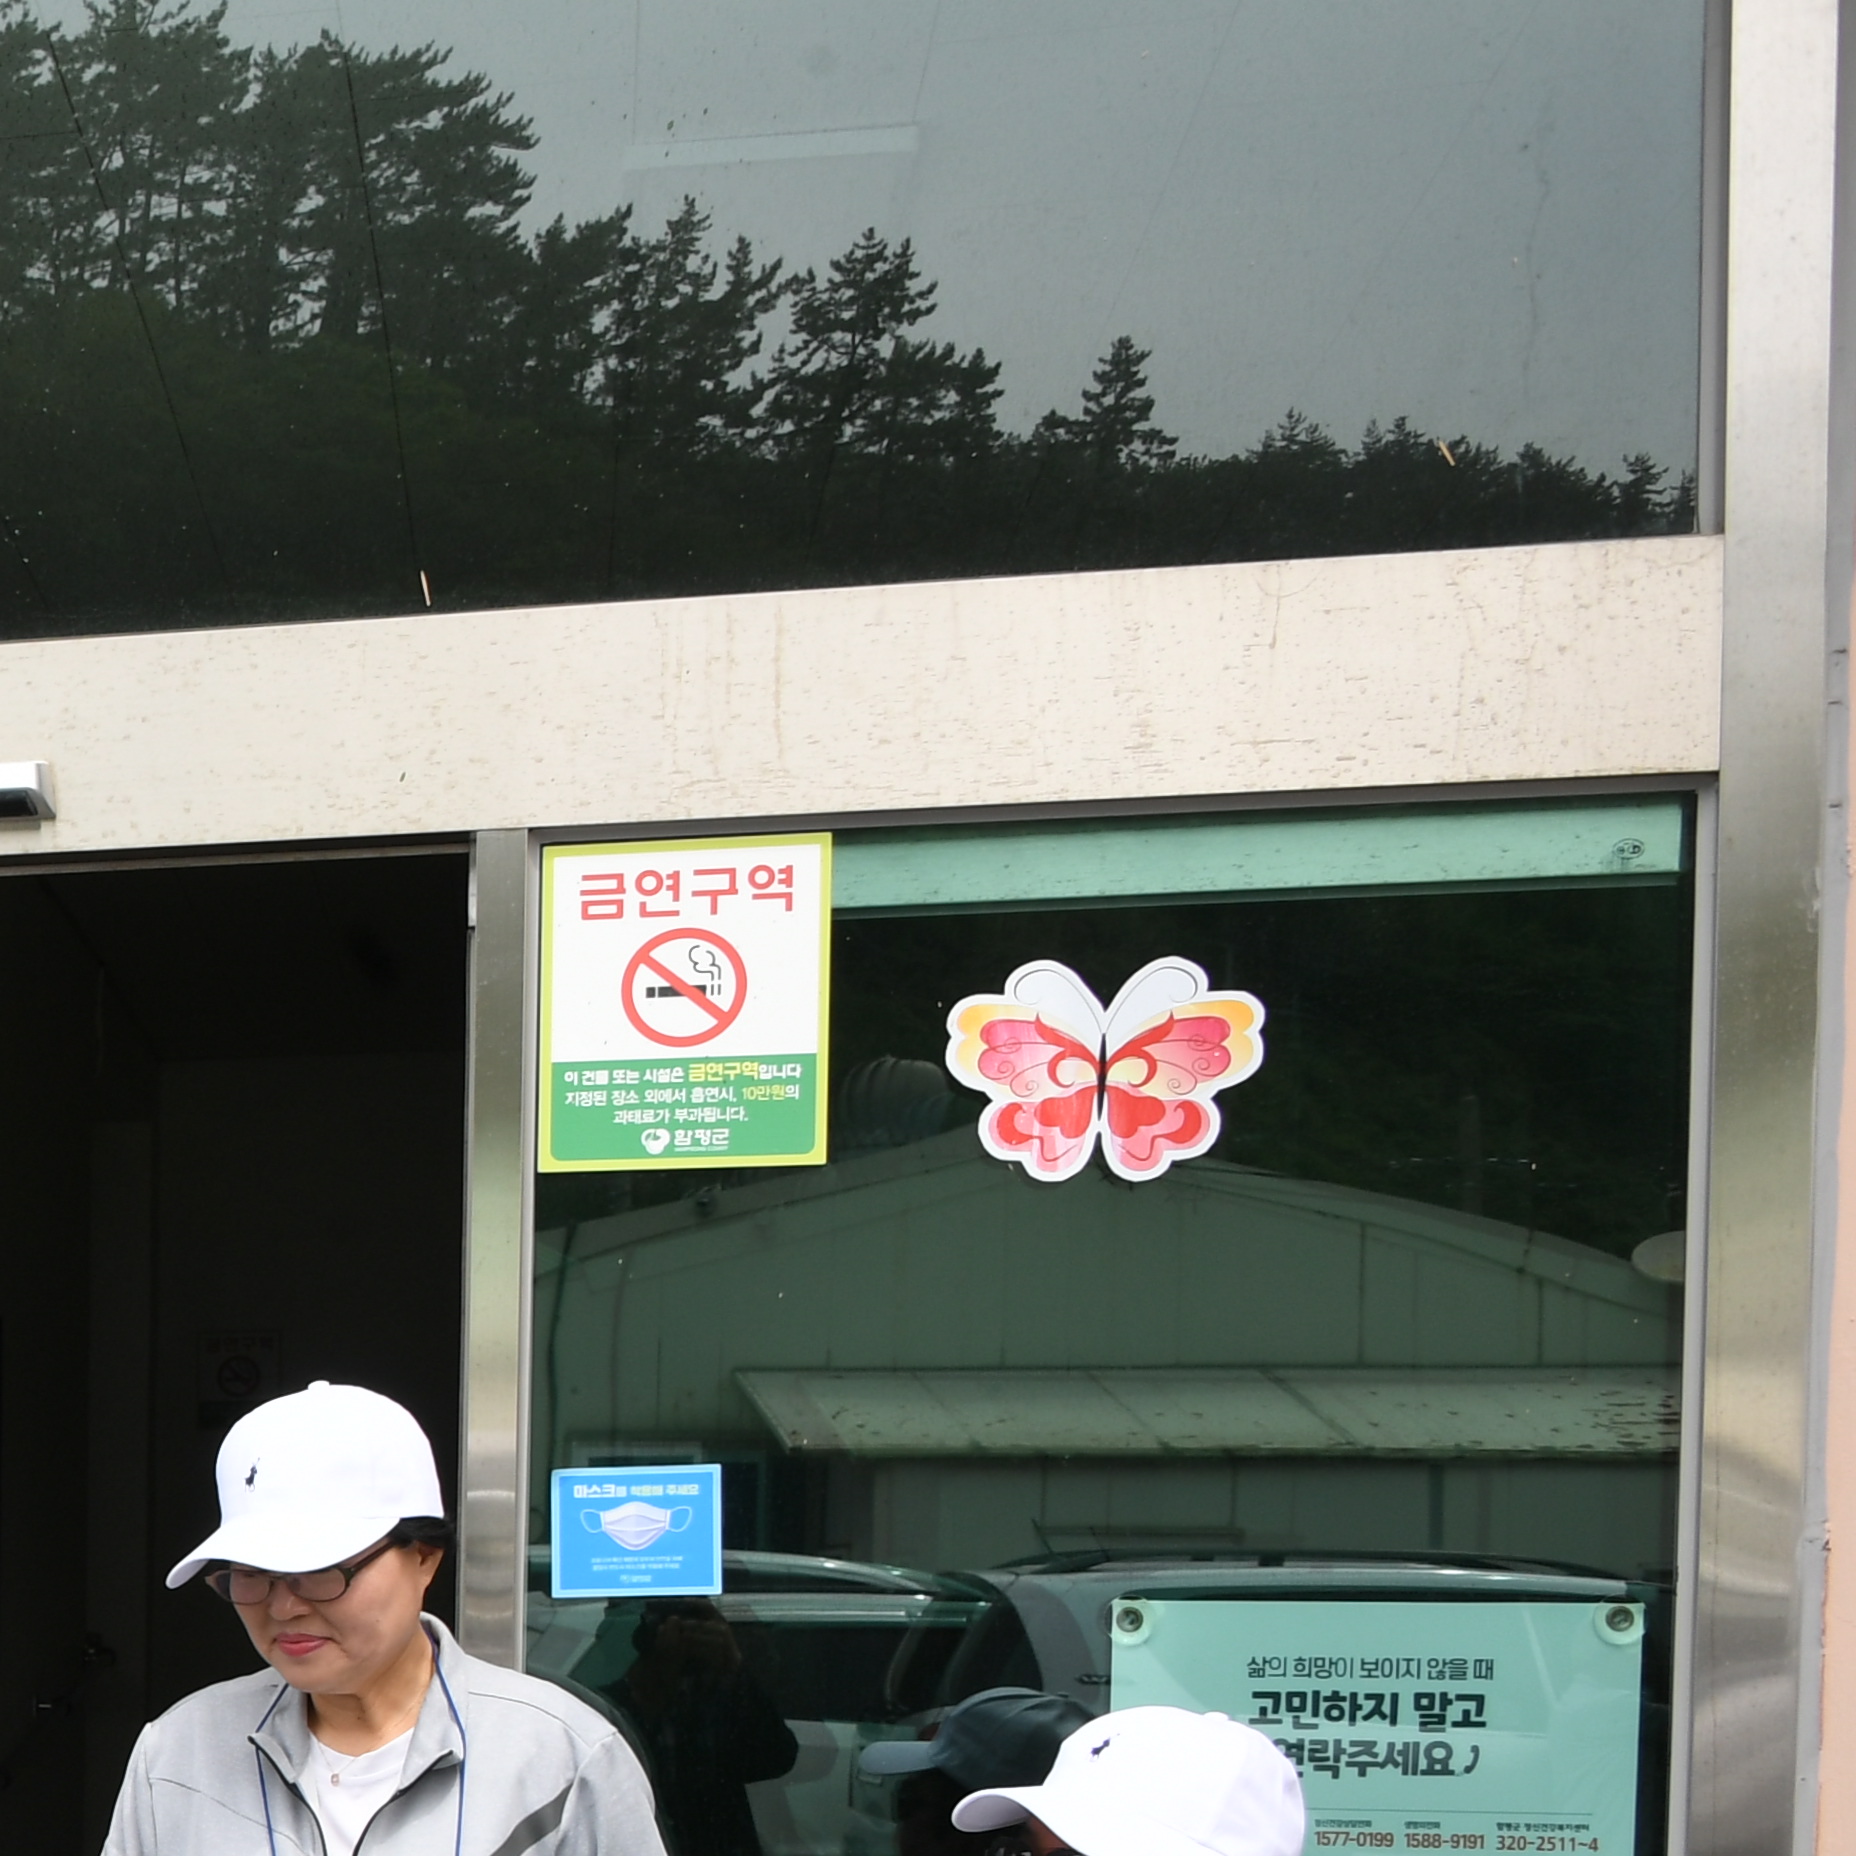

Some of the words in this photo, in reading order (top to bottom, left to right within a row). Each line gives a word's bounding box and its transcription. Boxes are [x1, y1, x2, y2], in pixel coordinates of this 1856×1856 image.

[579, 864, 794, 920] 금연구역
[564, 1071, 578, 1085] 이
[581, 1070, 609, 1085] 건물
[612, 1069, 640, 1084] 또는
[643, 1067, 684, 1083] 시설은
[564, 1091, 607, 1107] 지정된
[611, 1090, 640, 1106] 장소
[644, 1088, 686, 1104] 외에서
[742, 1084, 800, 1101] 10만원의
[613, 1108, 670, 1125] 과태료가
[674, 1106, 749, 1123] 부과됩니다.
[674, 1128, 729, 1146] 함평군
[1247, 1656, 1287, 1678] 삶의
[1292, 1656, 1354, 1679] 희망이
[1359, 1657, 1421, 1680] 보이지
[1427, 1658, 1469, 1681] 않을
[1473, 1658, 1494, 1681] 때
[1248, 1690, 1399, 1730] 고민하지
[1413, 1691, 1487, 1733] 말고
[1314, 1831, 1394, 1848] 1577-0199
[1404, 1833, 1485, 1850] 1588-9191
[1496, 1835, 1598, 1853] 320-2511~4
